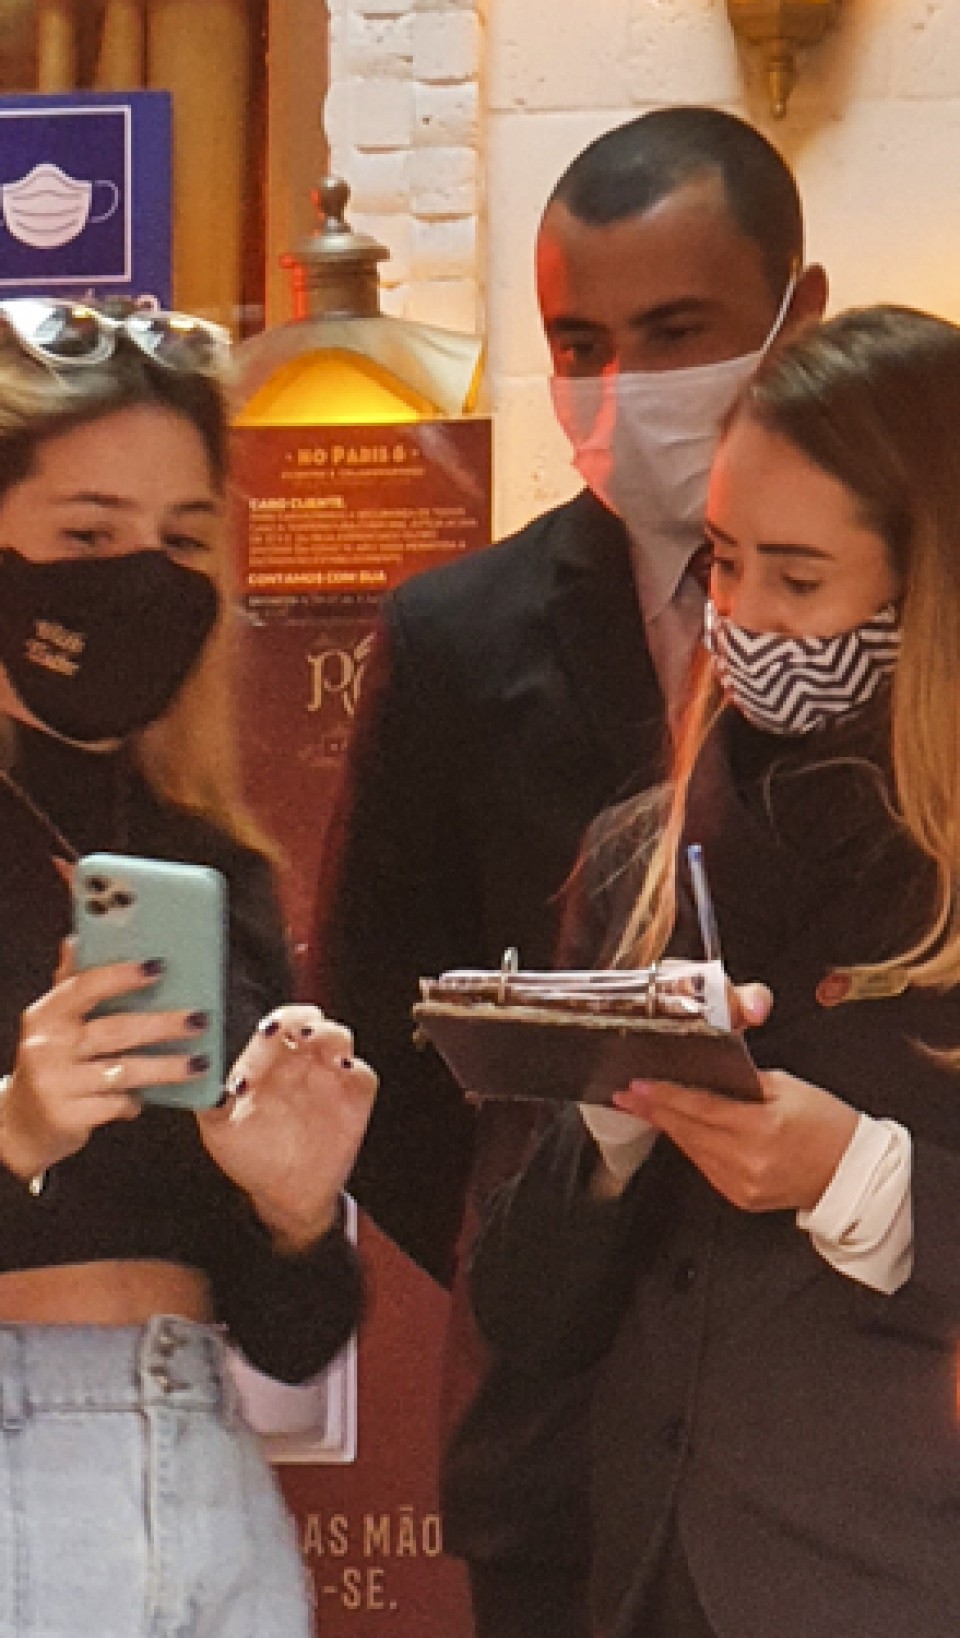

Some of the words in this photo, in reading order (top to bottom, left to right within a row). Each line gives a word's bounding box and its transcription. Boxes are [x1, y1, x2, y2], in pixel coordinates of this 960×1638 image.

[331, 445, 388, 465] PARIS
[303, 1513, 348, 1557] AS
[363, 1504, 443, 1557] MÃO
